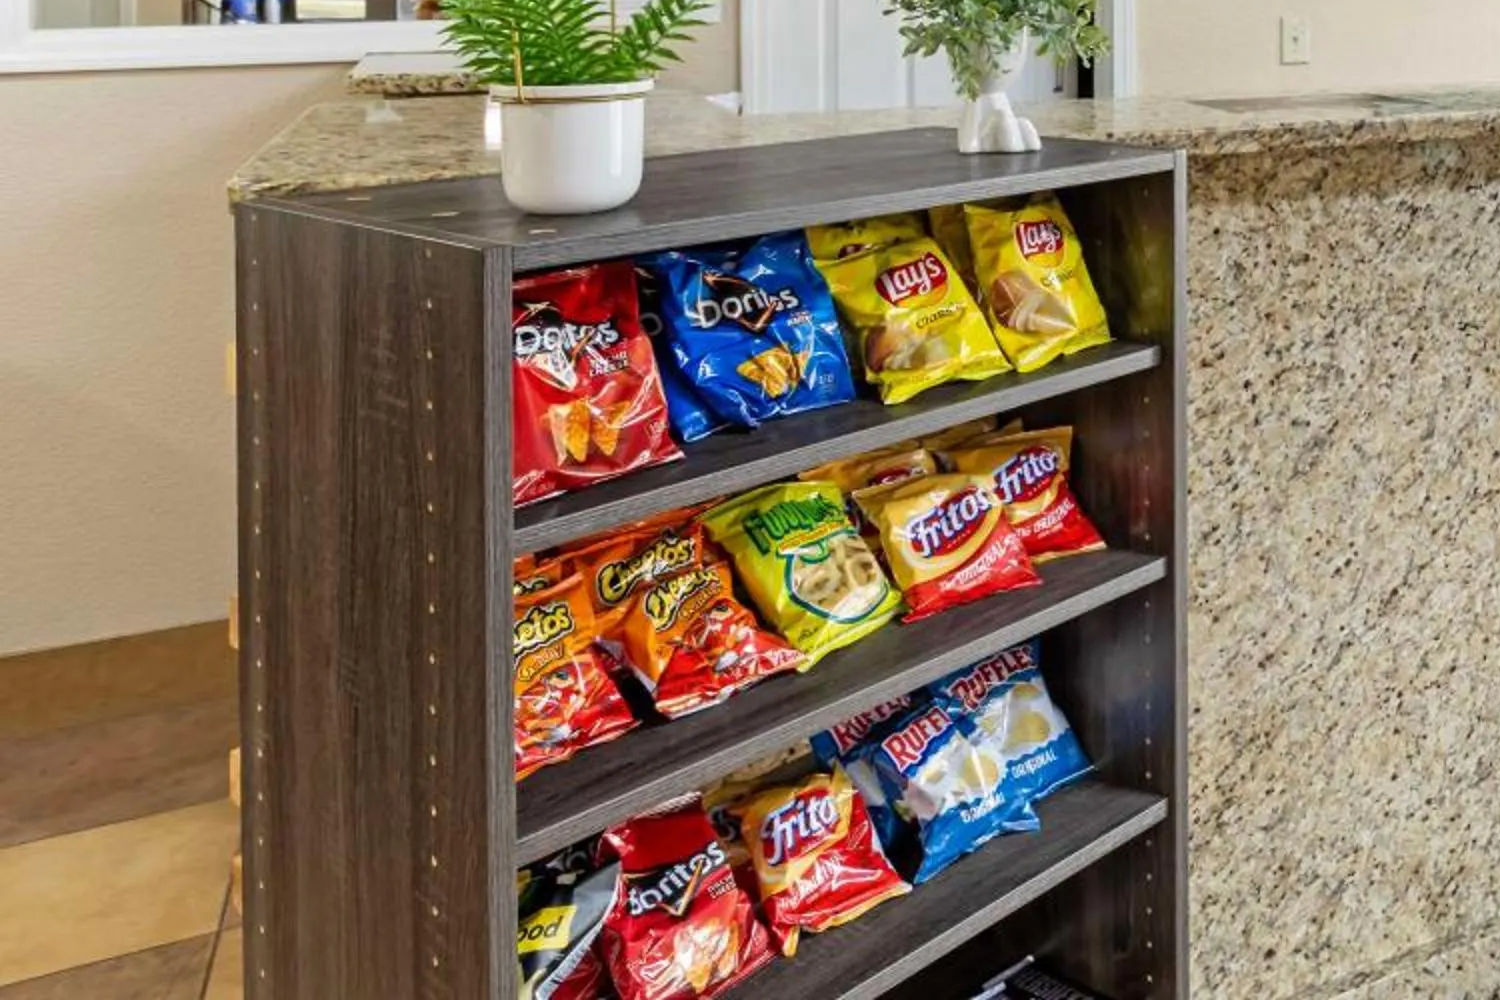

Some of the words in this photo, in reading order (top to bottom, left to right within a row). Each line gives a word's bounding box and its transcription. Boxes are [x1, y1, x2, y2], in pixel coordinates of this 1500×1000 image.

[880, 254, 942, 303] Lay's
[515, 322, 619, 356] Dotos
[992, 451, 1060, 505] Frito
[905, 487, 993, 559] Fritos
[601, 540, 689, 602] Cheetos
[882, 706, 952, 773] RUFF
[762, 795, 838, 867] Frito
